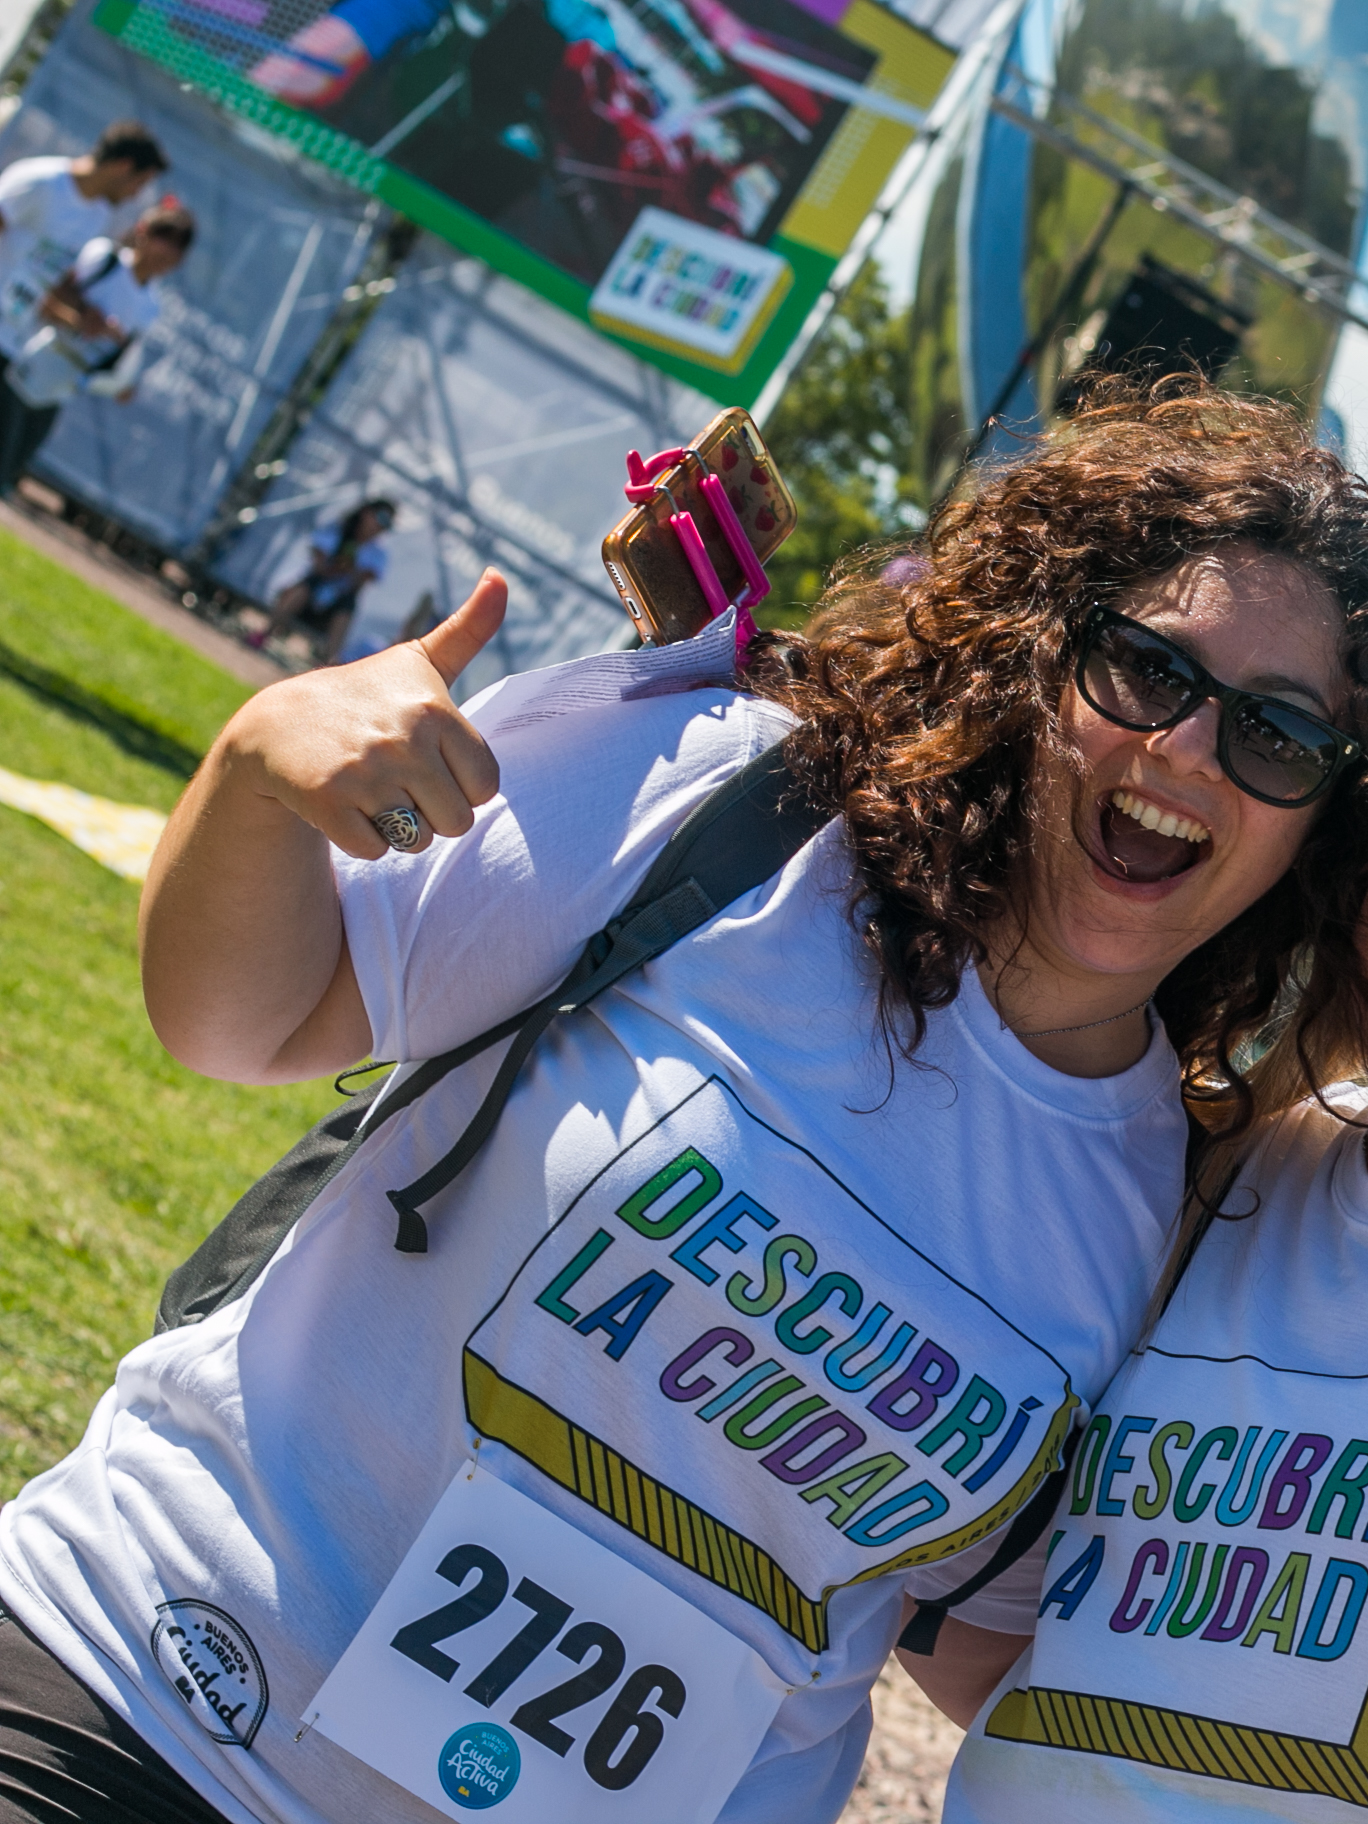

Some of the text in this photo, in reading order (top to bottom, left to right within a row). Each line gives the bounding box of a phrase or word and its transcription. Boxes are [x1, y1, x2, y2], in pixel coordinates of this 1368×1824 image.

[614, 1146, 1045, 1495] DESCUBRÍ
[534, 1228, 950, 1547] LA CIUDAD
[940, 1507, 1011, 1555] AIRES
[200, 1635, 237, 1675] AIRES
[204, 1620, 250, 1674] BUENOS
[389, 1543, 687, 1791] 2726
[459, 1739, 511, 1782] Ciudad
[481, 1731, 510, 1753] BUENOS
[481, 1739, 503, 1756] AIRES
